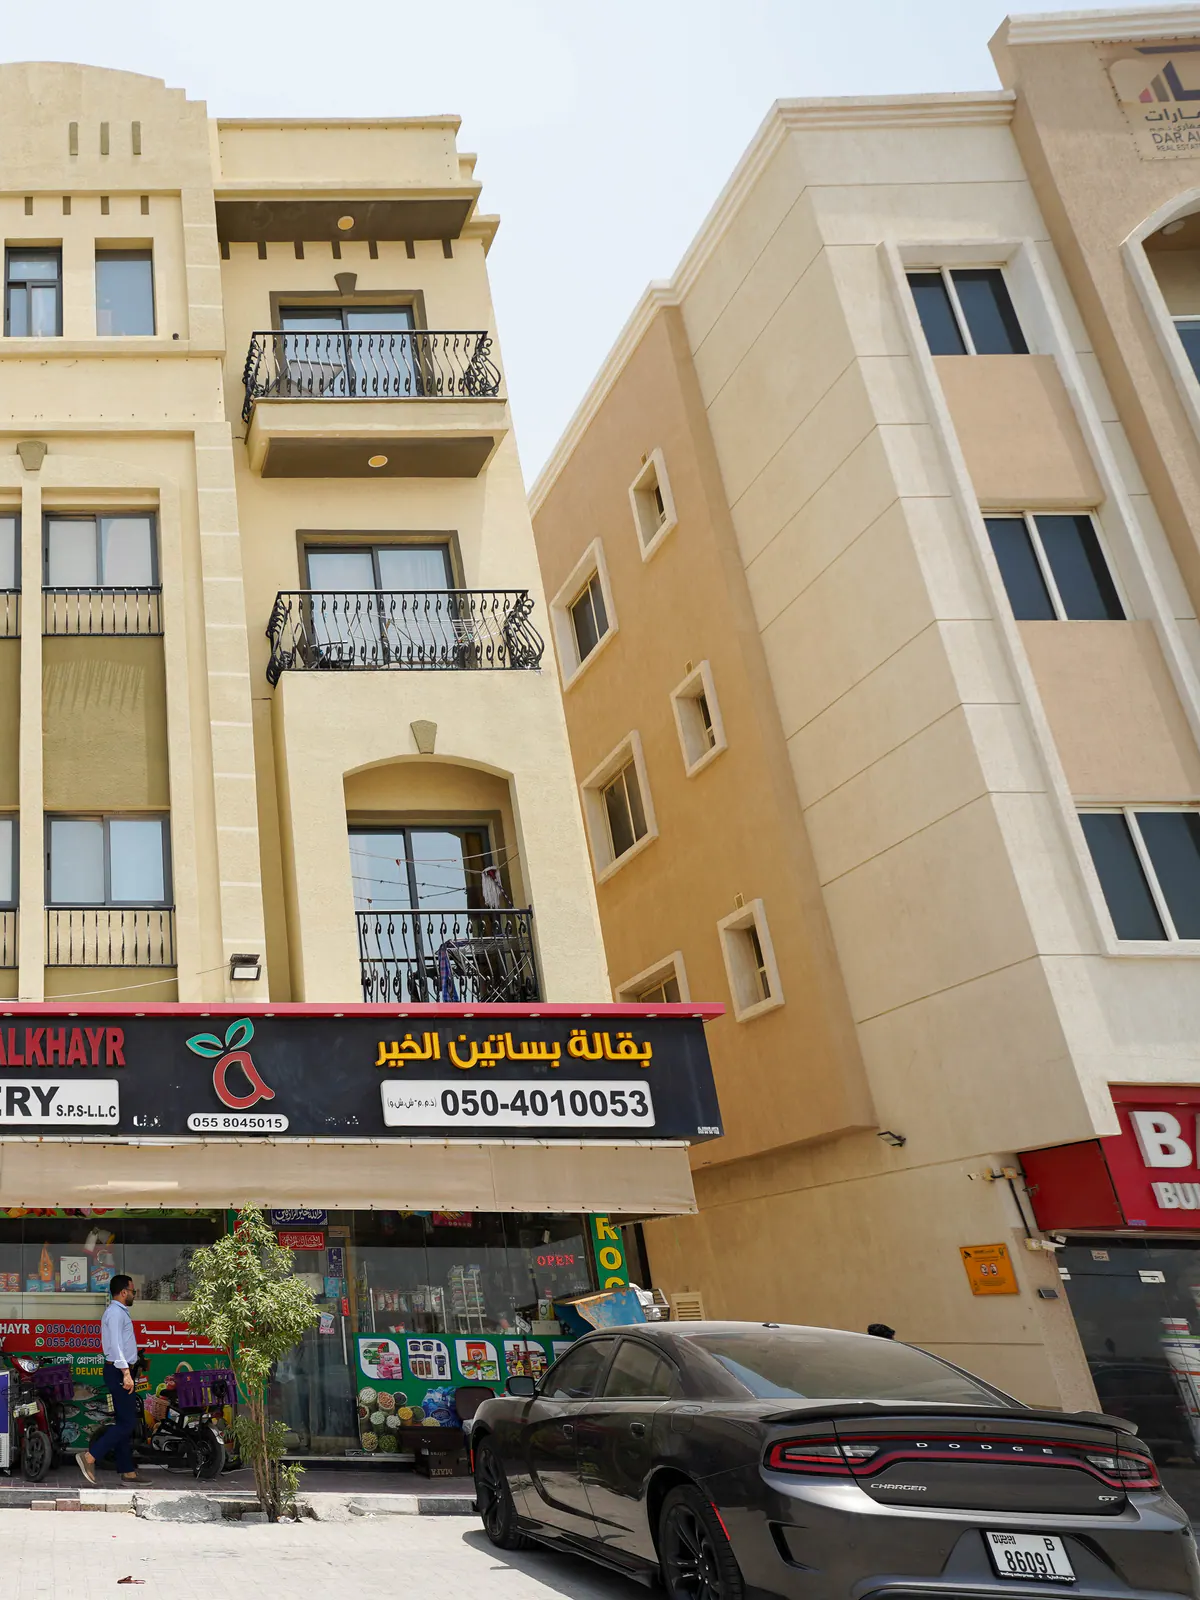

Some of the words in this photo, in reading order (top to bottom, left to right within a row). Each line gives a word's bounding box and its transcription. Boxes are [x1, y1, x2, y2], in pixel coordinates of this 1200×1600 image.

[1152, 131, 1184, 144] DAR
[374, 1032, 440, 1067] الخير
[447, 1032, 562, 1069] بساتين
[567, 1029, 653, 1068] بقالة
[441, 1089, 650, 1118] 050-4010053
[193, 1117, 218, 1128] 055
[223, 1117, 282, 1129] 8045015
[536, 1254, 575, 1266] OPEN
[915, 1441, 1054, 1454] DODGE
[870, 1482, 927, 1492] CHARGER
[1043, 1537, 1055, 1551] B
[1004, 1549, 1056, 1574] 86091
